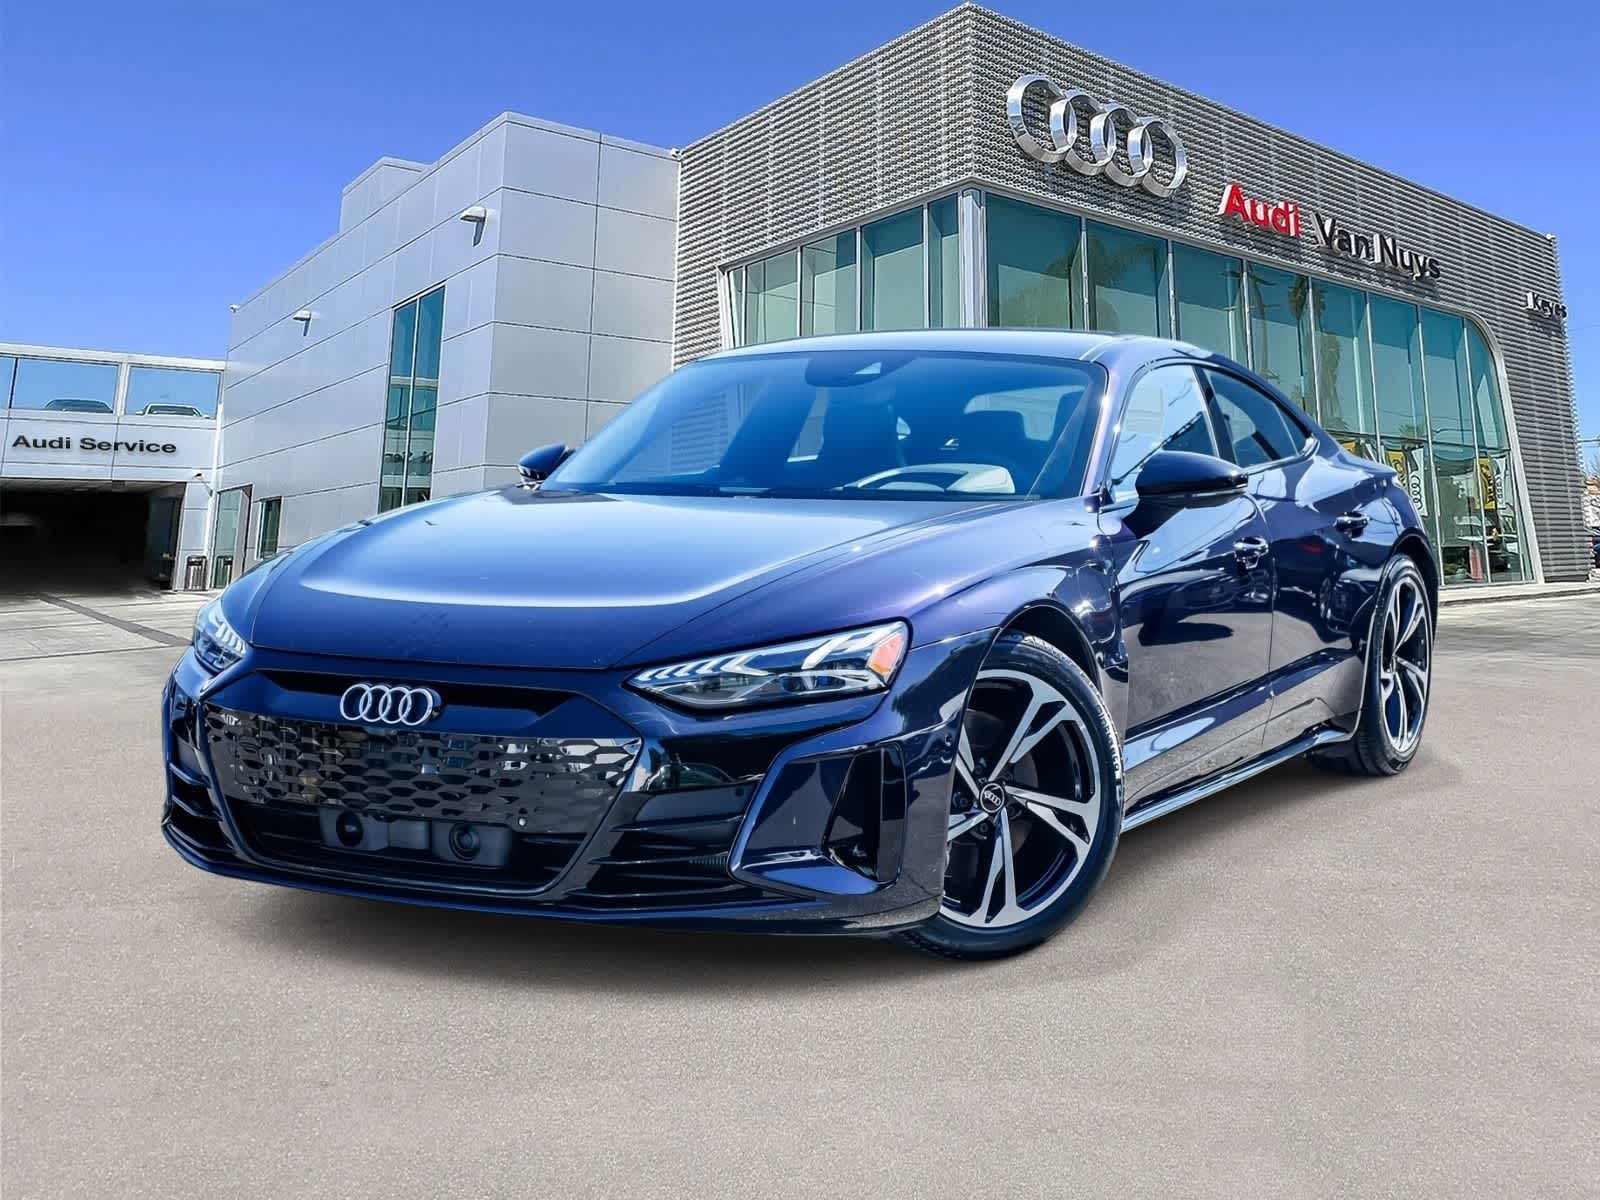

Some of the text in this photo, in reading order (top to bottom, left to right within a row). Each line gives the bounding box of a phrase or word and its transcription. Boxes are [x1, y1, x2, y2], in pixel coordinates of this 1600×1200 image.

[1220, 183, 1441, 280] Audi Van Nuys
[1527, 292, 1567, 318] Keyes
[12, 435, 177, 453] Audi Service
